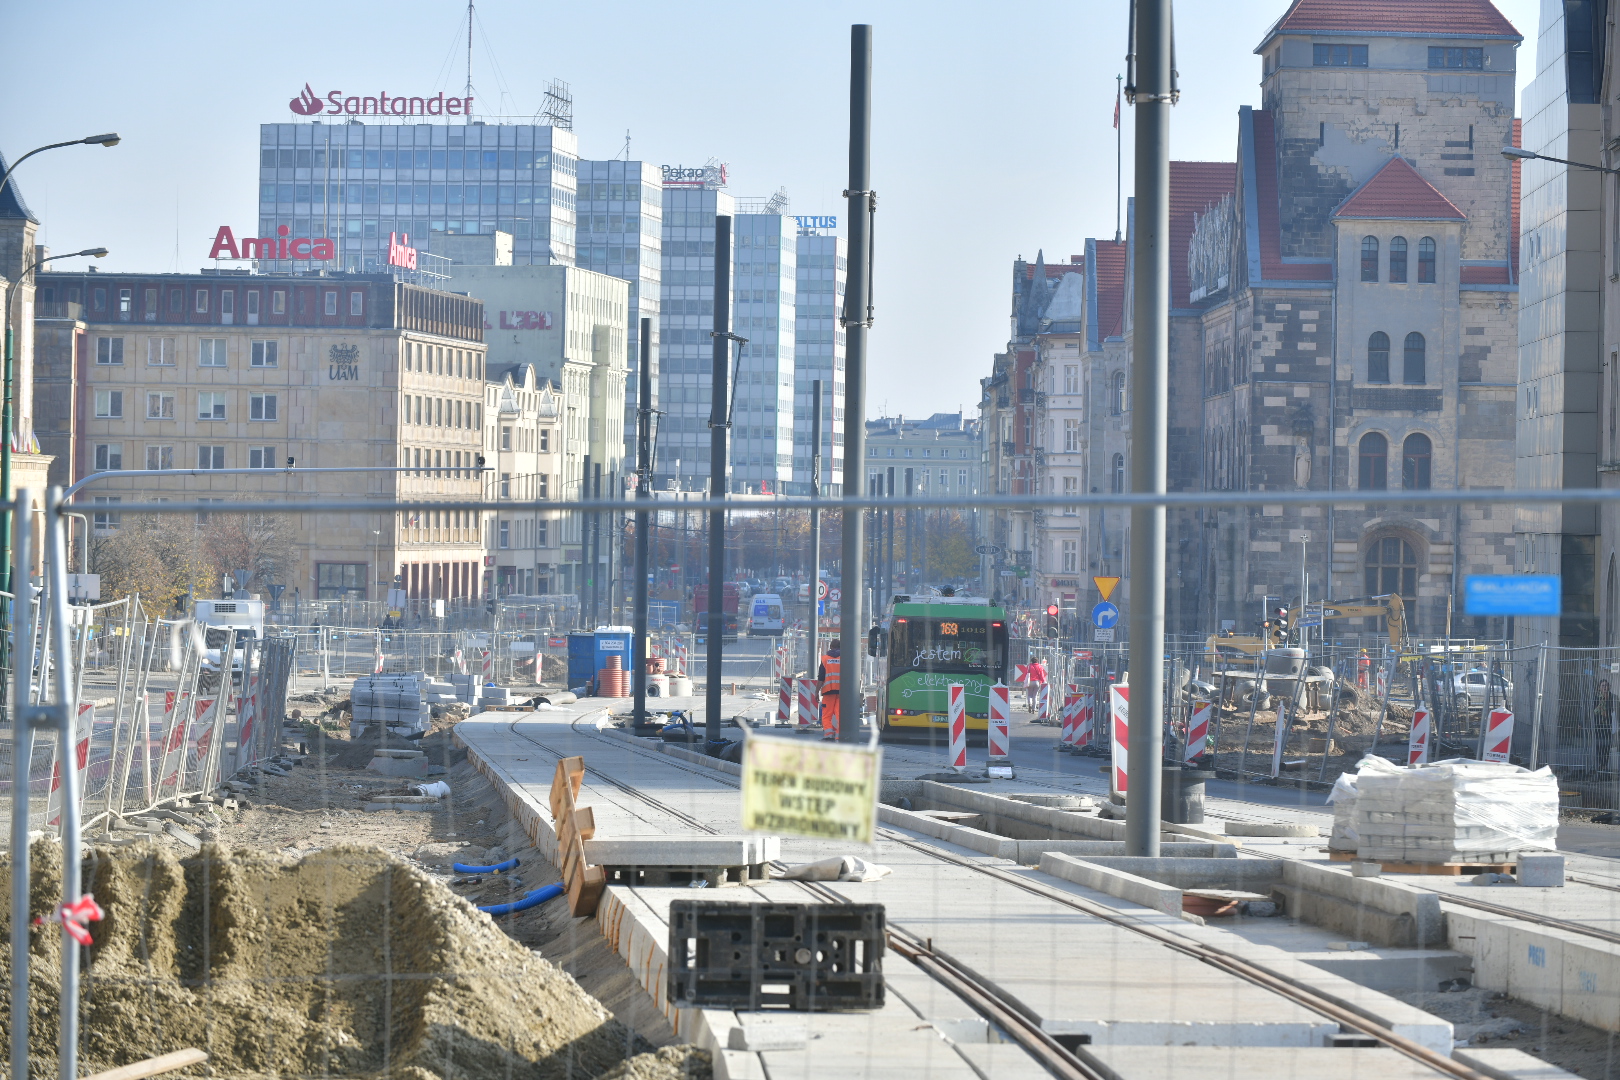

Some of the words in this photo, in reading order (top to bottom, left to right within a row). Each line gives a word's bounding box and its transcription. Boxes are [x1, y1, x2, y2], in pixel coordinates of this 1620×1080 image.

[327, 90, 474, 116] Santander
[661, 164, 705, 179] Pekao
[795, 215, 837, 229] ALTUS
[208, 225, 335, 260] Amica
[388, 231, 417, 271] Amica
[328, 364, 359, 381] UAM
[912, 645, 961, 667] jestem
[803, 776, 865, 796] BUDOWY
